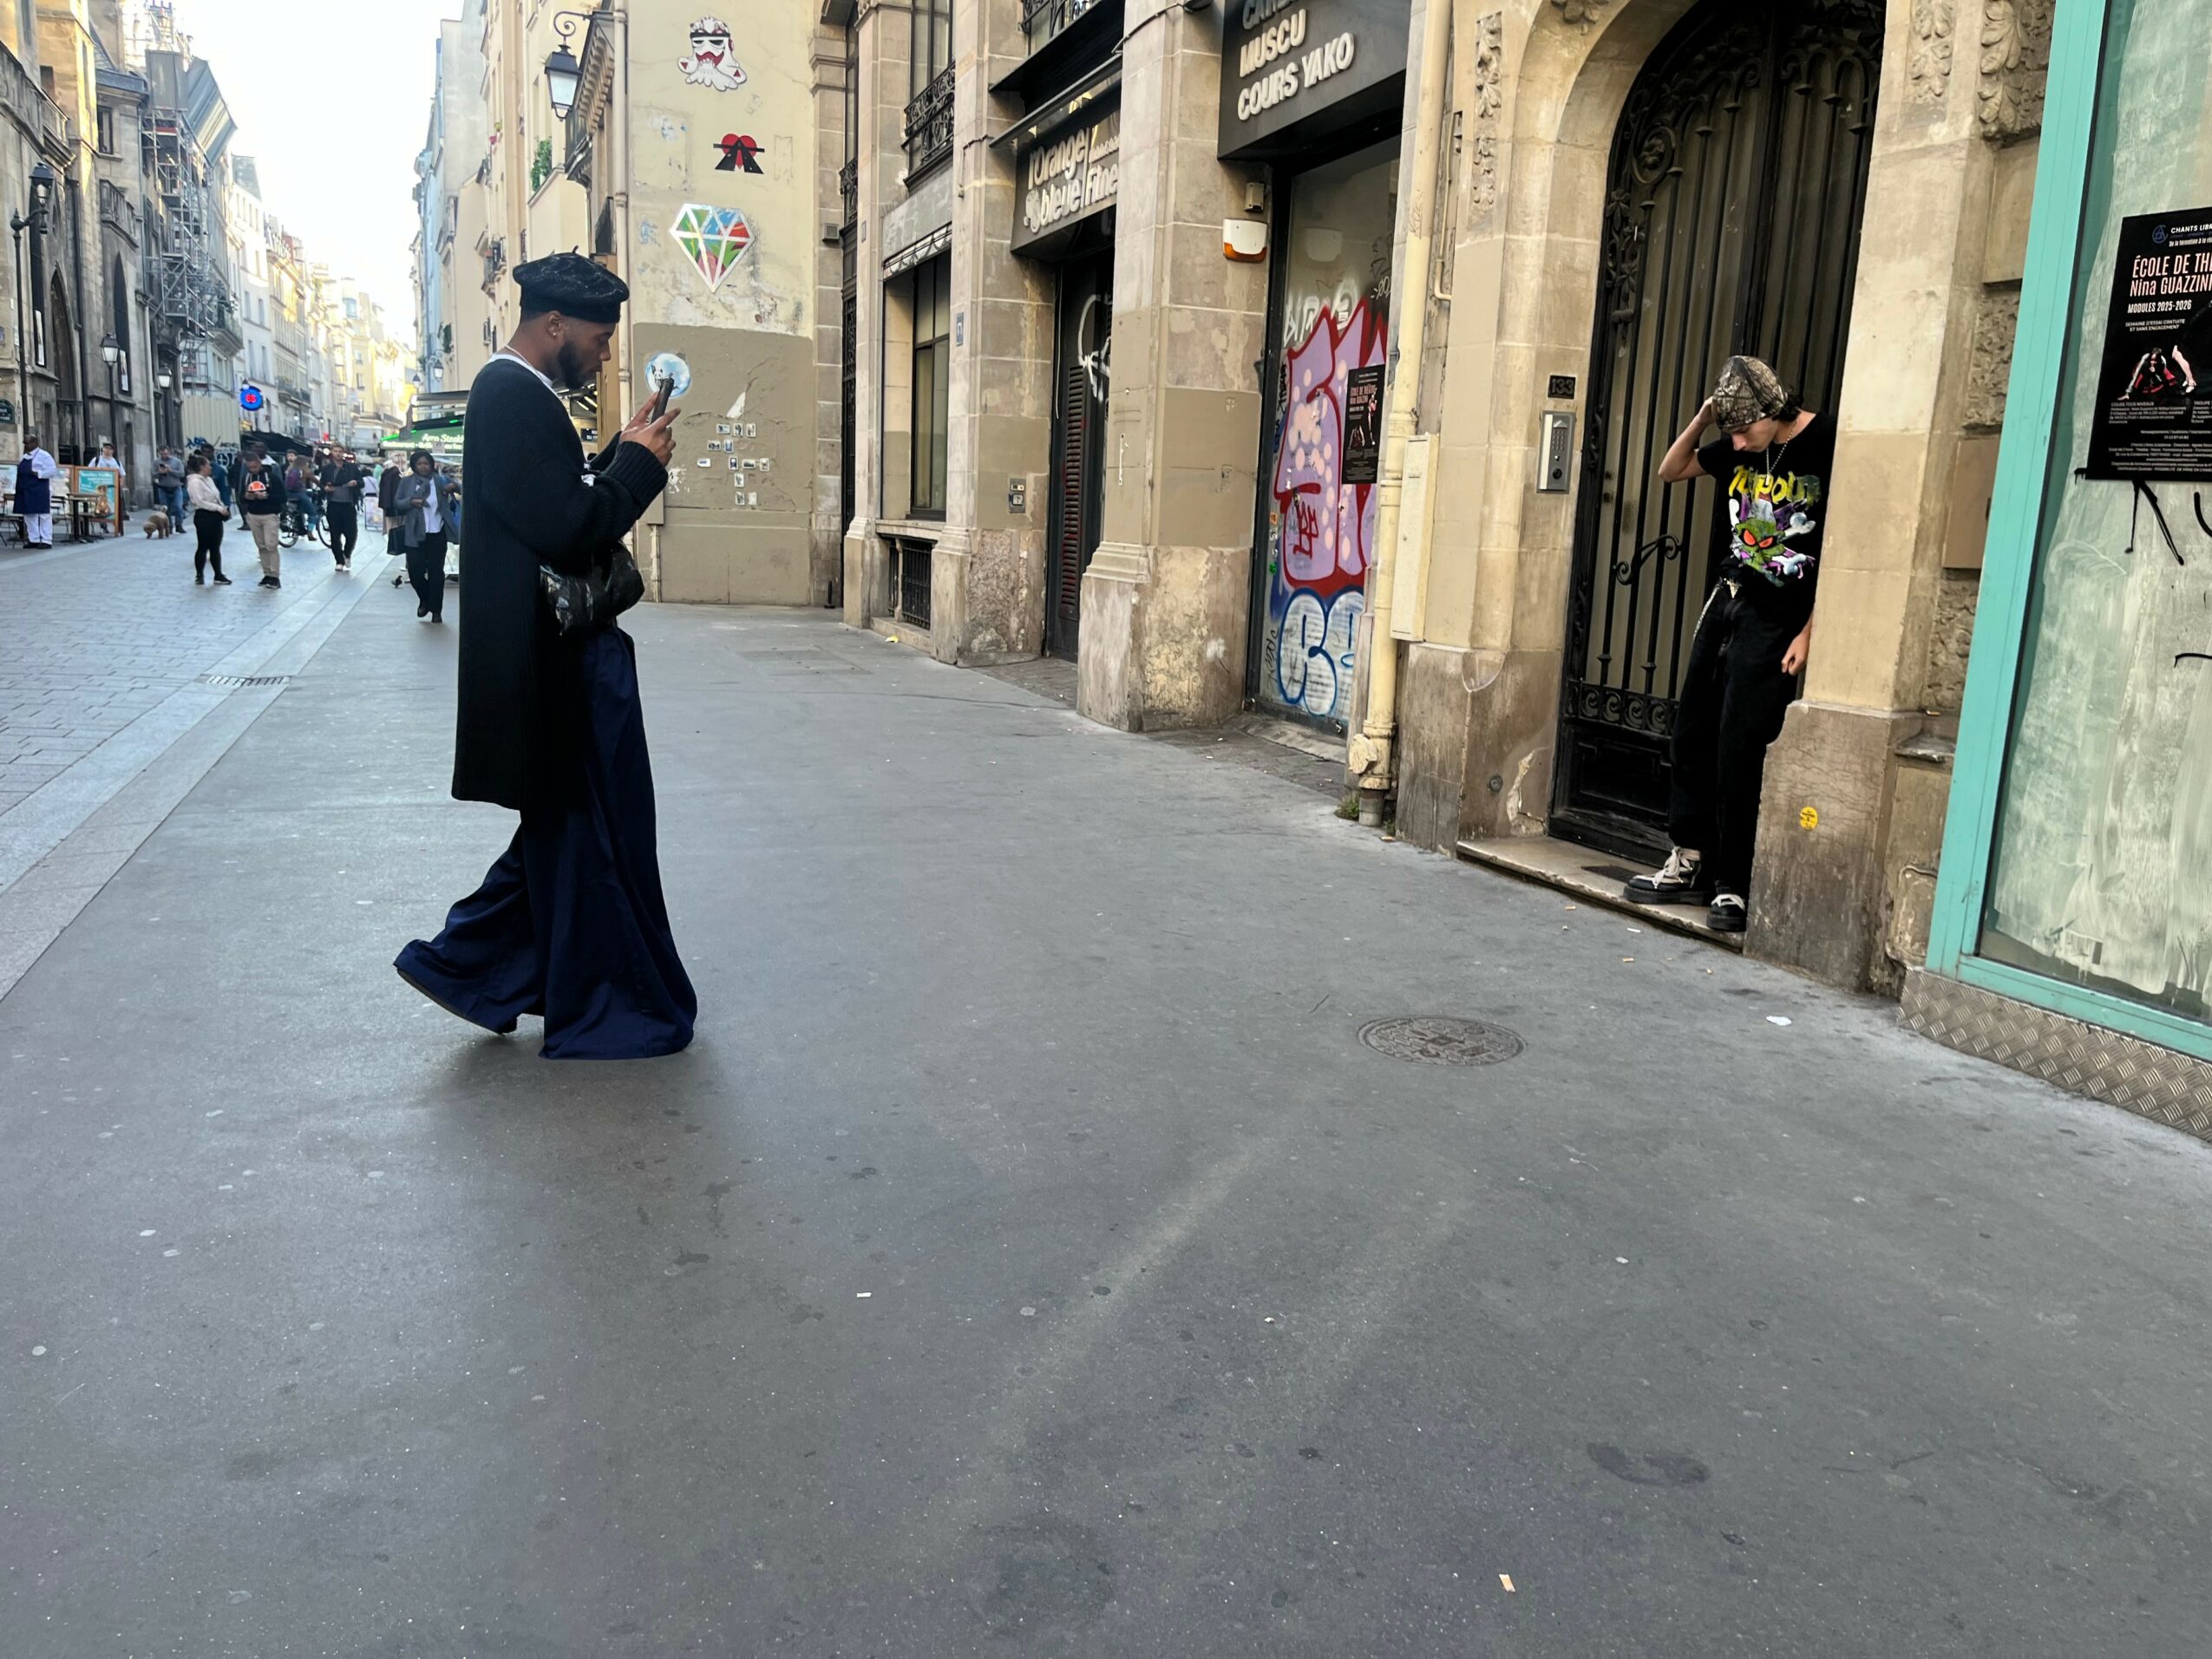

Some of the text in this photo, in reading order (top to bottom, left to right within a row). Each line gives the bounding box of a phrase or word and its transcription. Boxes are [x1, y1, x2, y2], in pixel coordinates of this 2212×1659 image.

[1240, 9, 1306, 78] MUSCU
[1238, 32, 1355, 121] COURS YAKO
[1041, 179, 1082, 226] bleue
[2170, 225, 2198, 233] CHANTS
[2132, 255, 2170, 278] ÉCOLE
[2173, 253, 2191, 275] DE
[2130, 278, 2157, 297] Nina
[2127, 299, 2192, 314] MODULES 2025-2026
[1551, 378, 1574, 395] 133
